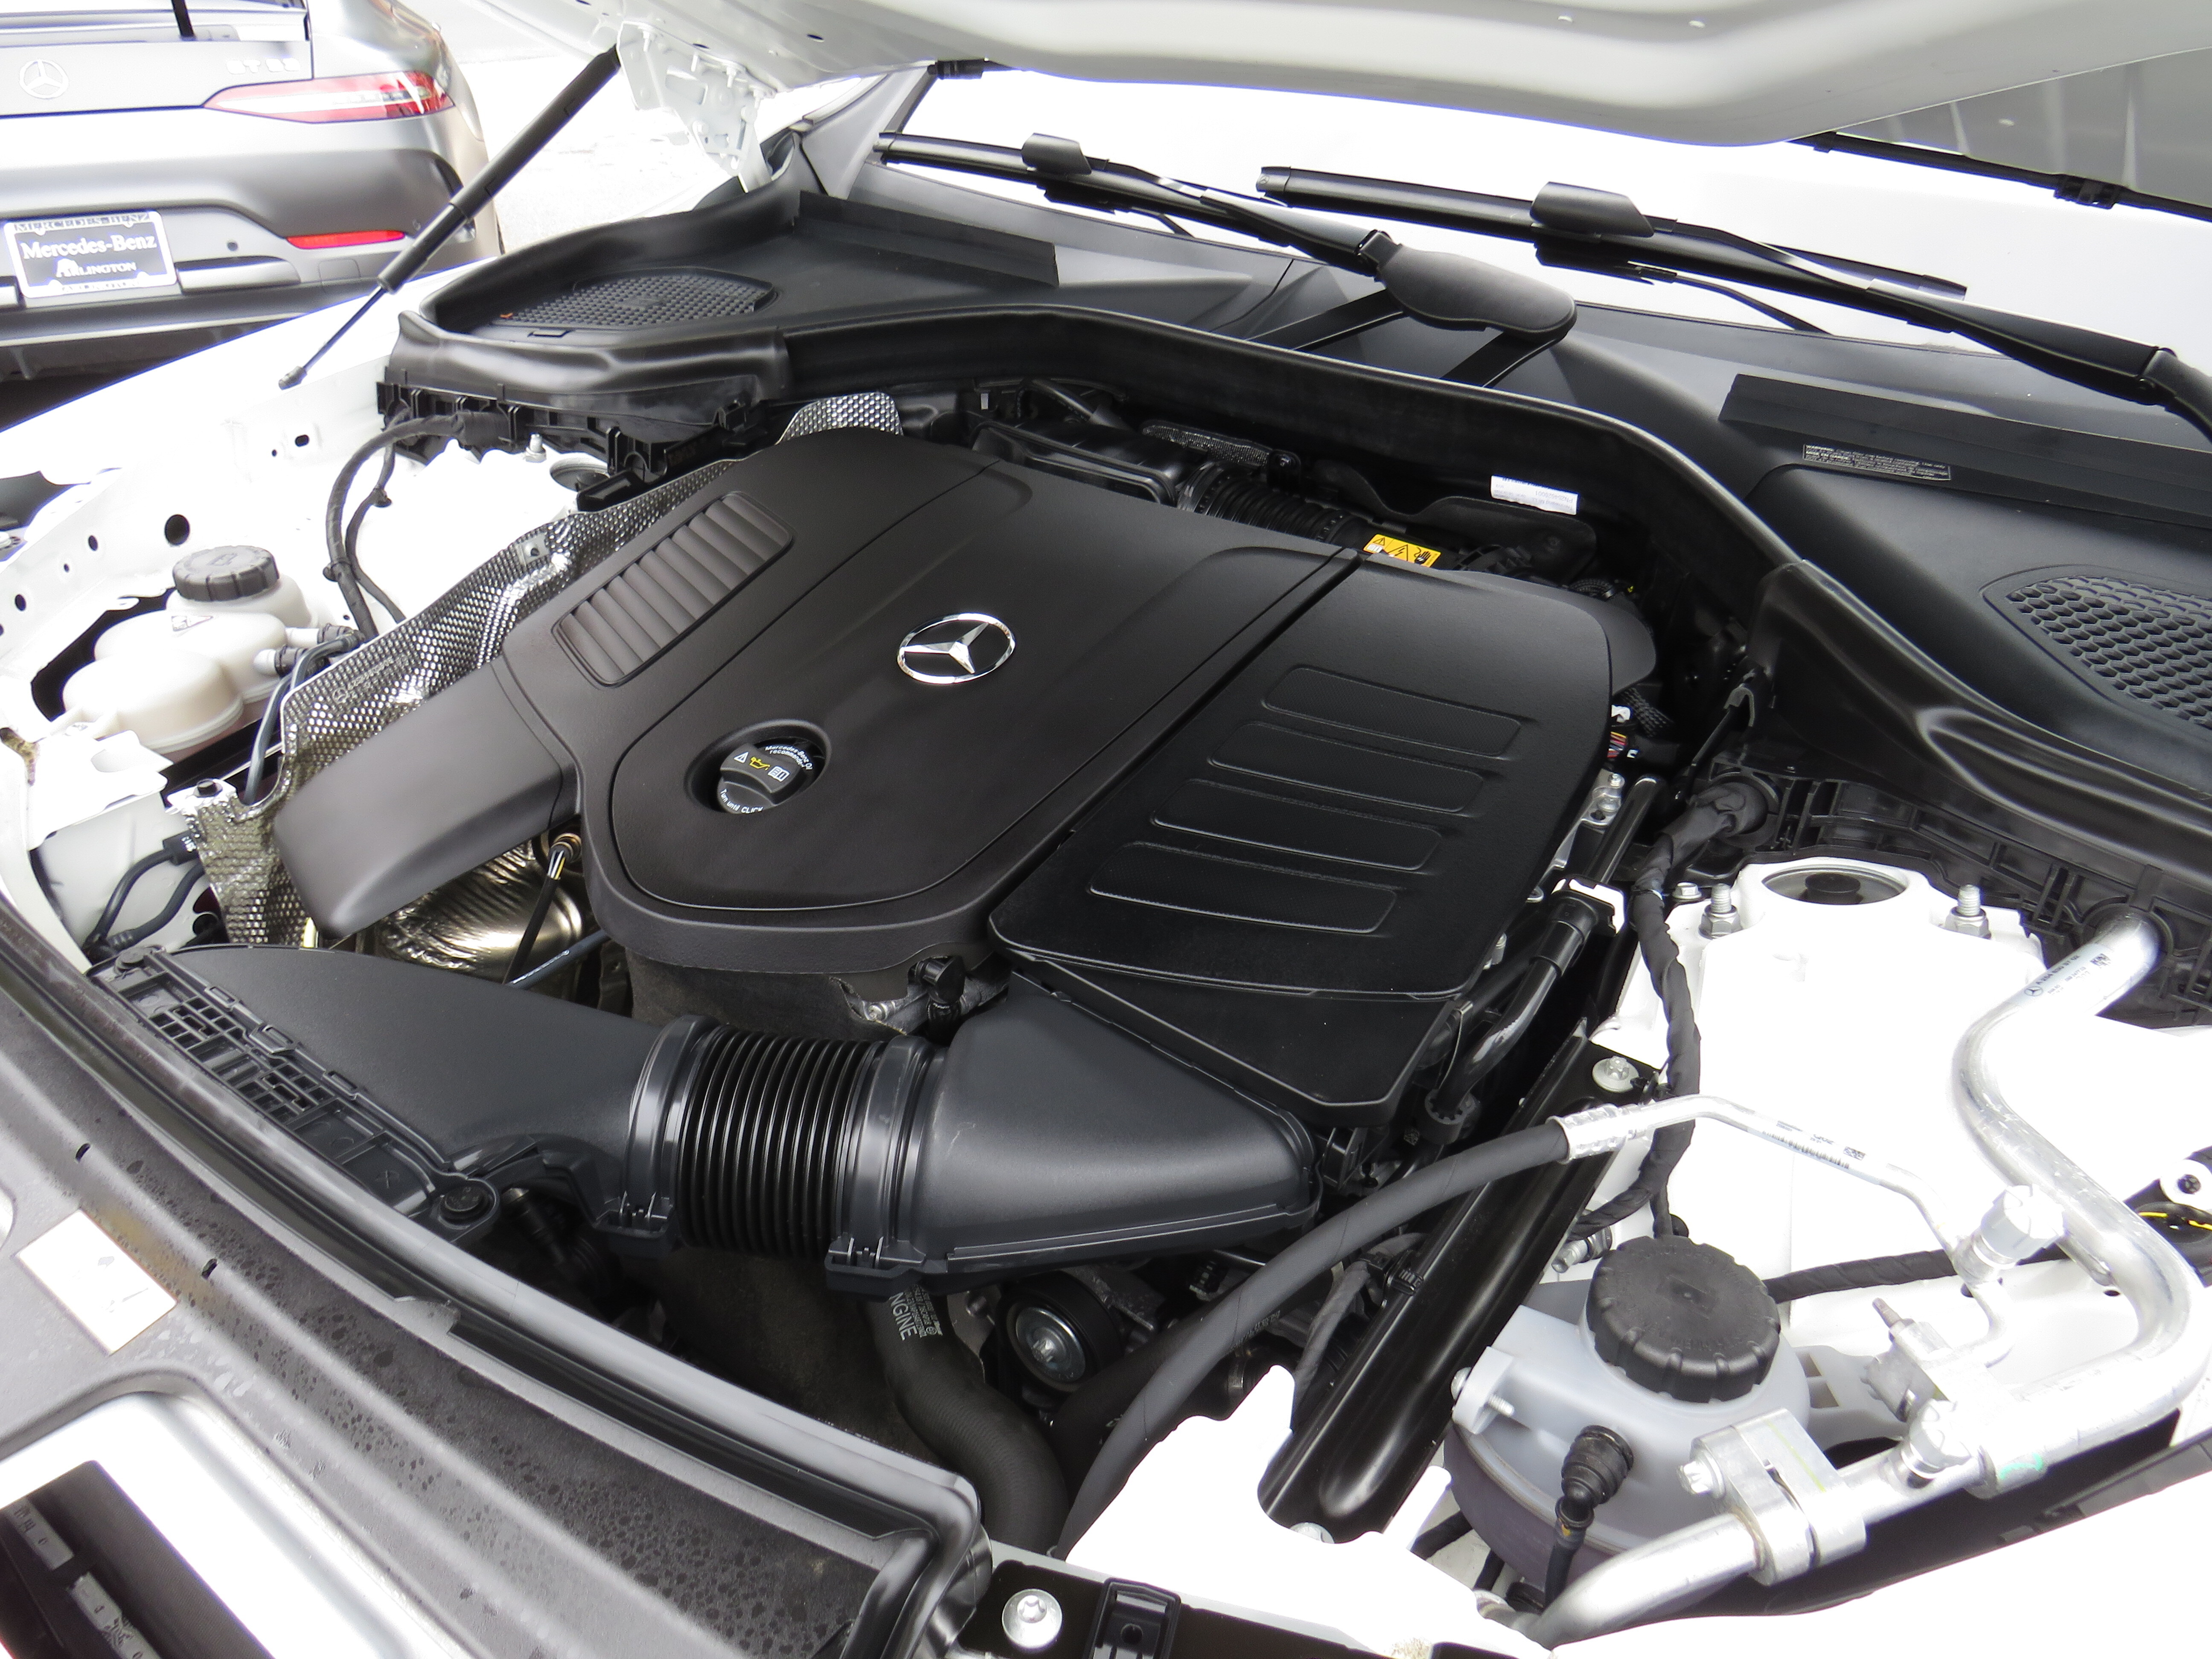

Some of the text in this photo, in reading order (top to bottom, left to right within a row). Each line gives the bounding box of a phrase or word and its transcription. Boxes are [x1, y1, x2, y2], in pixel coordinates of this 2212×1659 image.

[20, 234, 157, 259] Mercedes-Benz
[720, 789, 728, 803] Turn
[726, 801, 741, 811] until
[888, 1292, 918, 1341] NGINE
